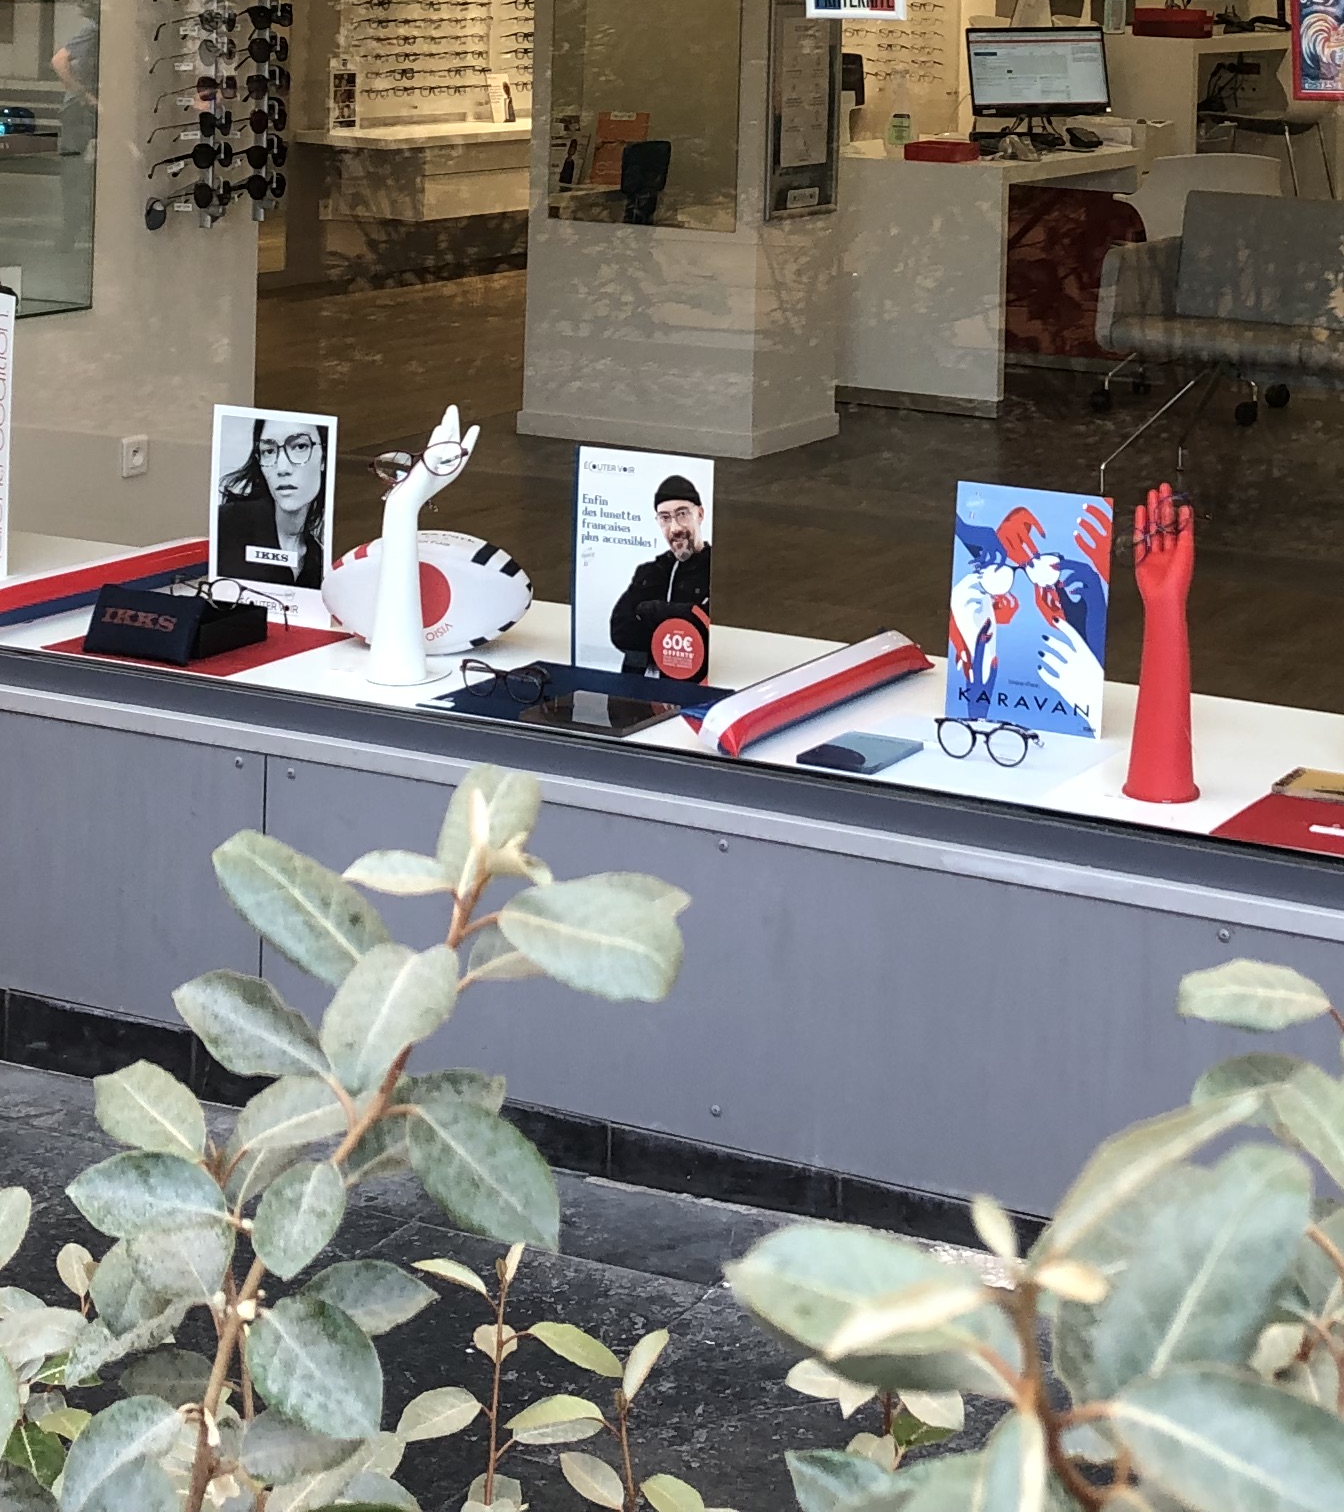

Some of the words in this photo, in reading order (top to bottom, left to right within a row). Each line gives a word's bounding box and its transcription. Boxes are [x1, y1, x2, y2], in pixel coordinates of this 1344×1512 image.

[582, 493, 609, 507] Enfin
[582, 506, 598, 517] des
[599, 507, 642, 522] lunettes
[581, 531, 600, 544] plus
[602, 535, 652, 549] accessibles
[254, 550, 290, 564] IKKS
[101, 607, 178, 633] IKKS
[662, 633, 694, 652] 60€
[958, 686, 1090, 718] KARAVAN
